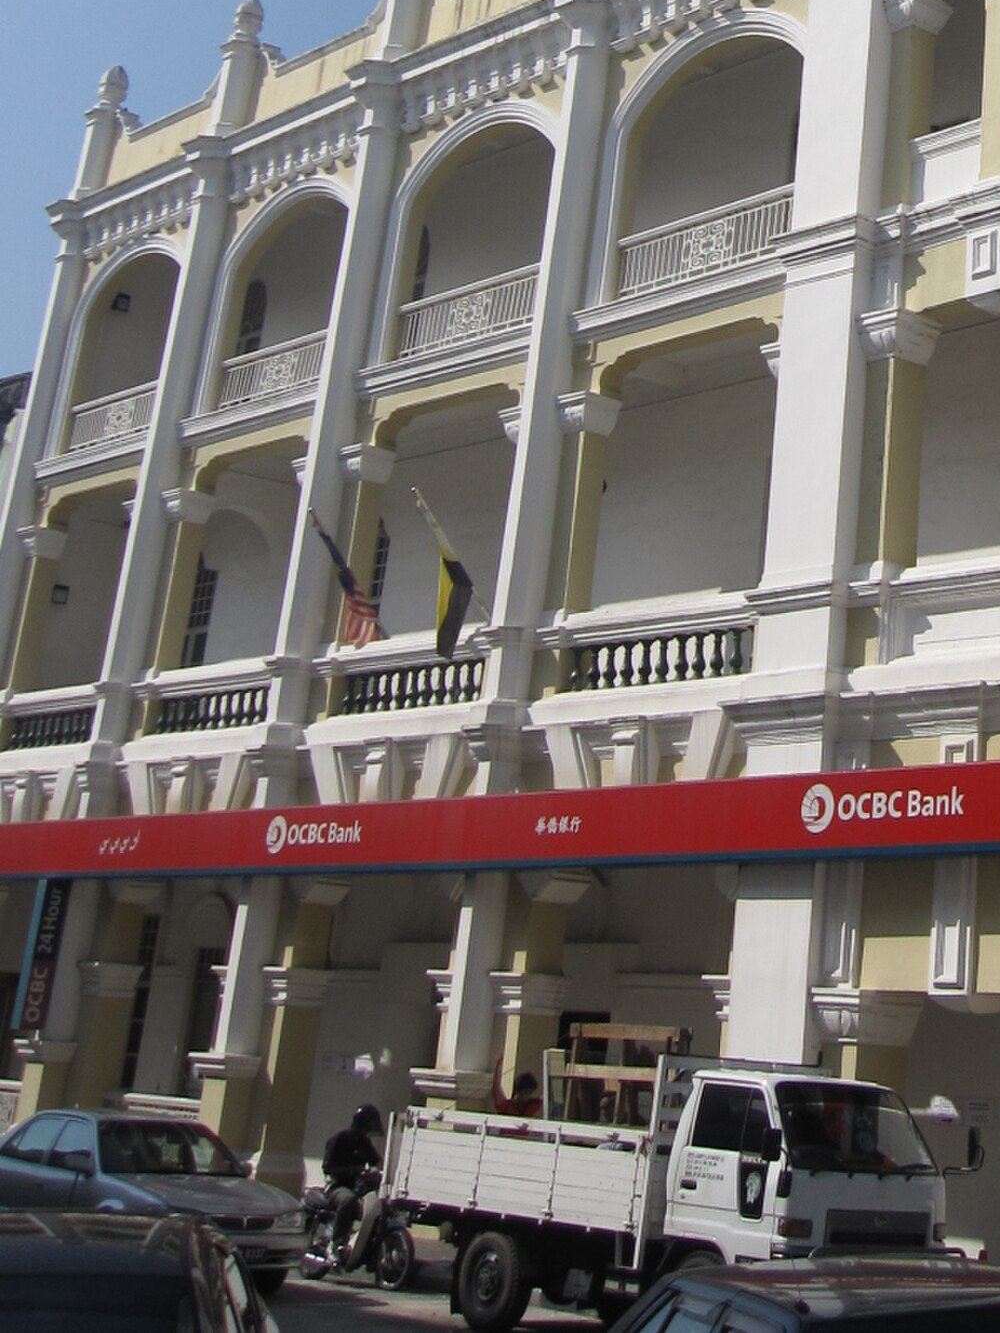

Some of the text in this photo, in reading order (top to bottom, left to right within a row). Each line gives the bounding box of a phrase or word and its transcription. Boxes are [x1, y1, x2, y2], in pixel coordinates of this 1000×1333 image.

[838, 785, 965, 821] OCBC Bank
[287, 819, 362, 845] OCBC Bank
[25, 887, 64, 1023] OCBC 24 Hour
